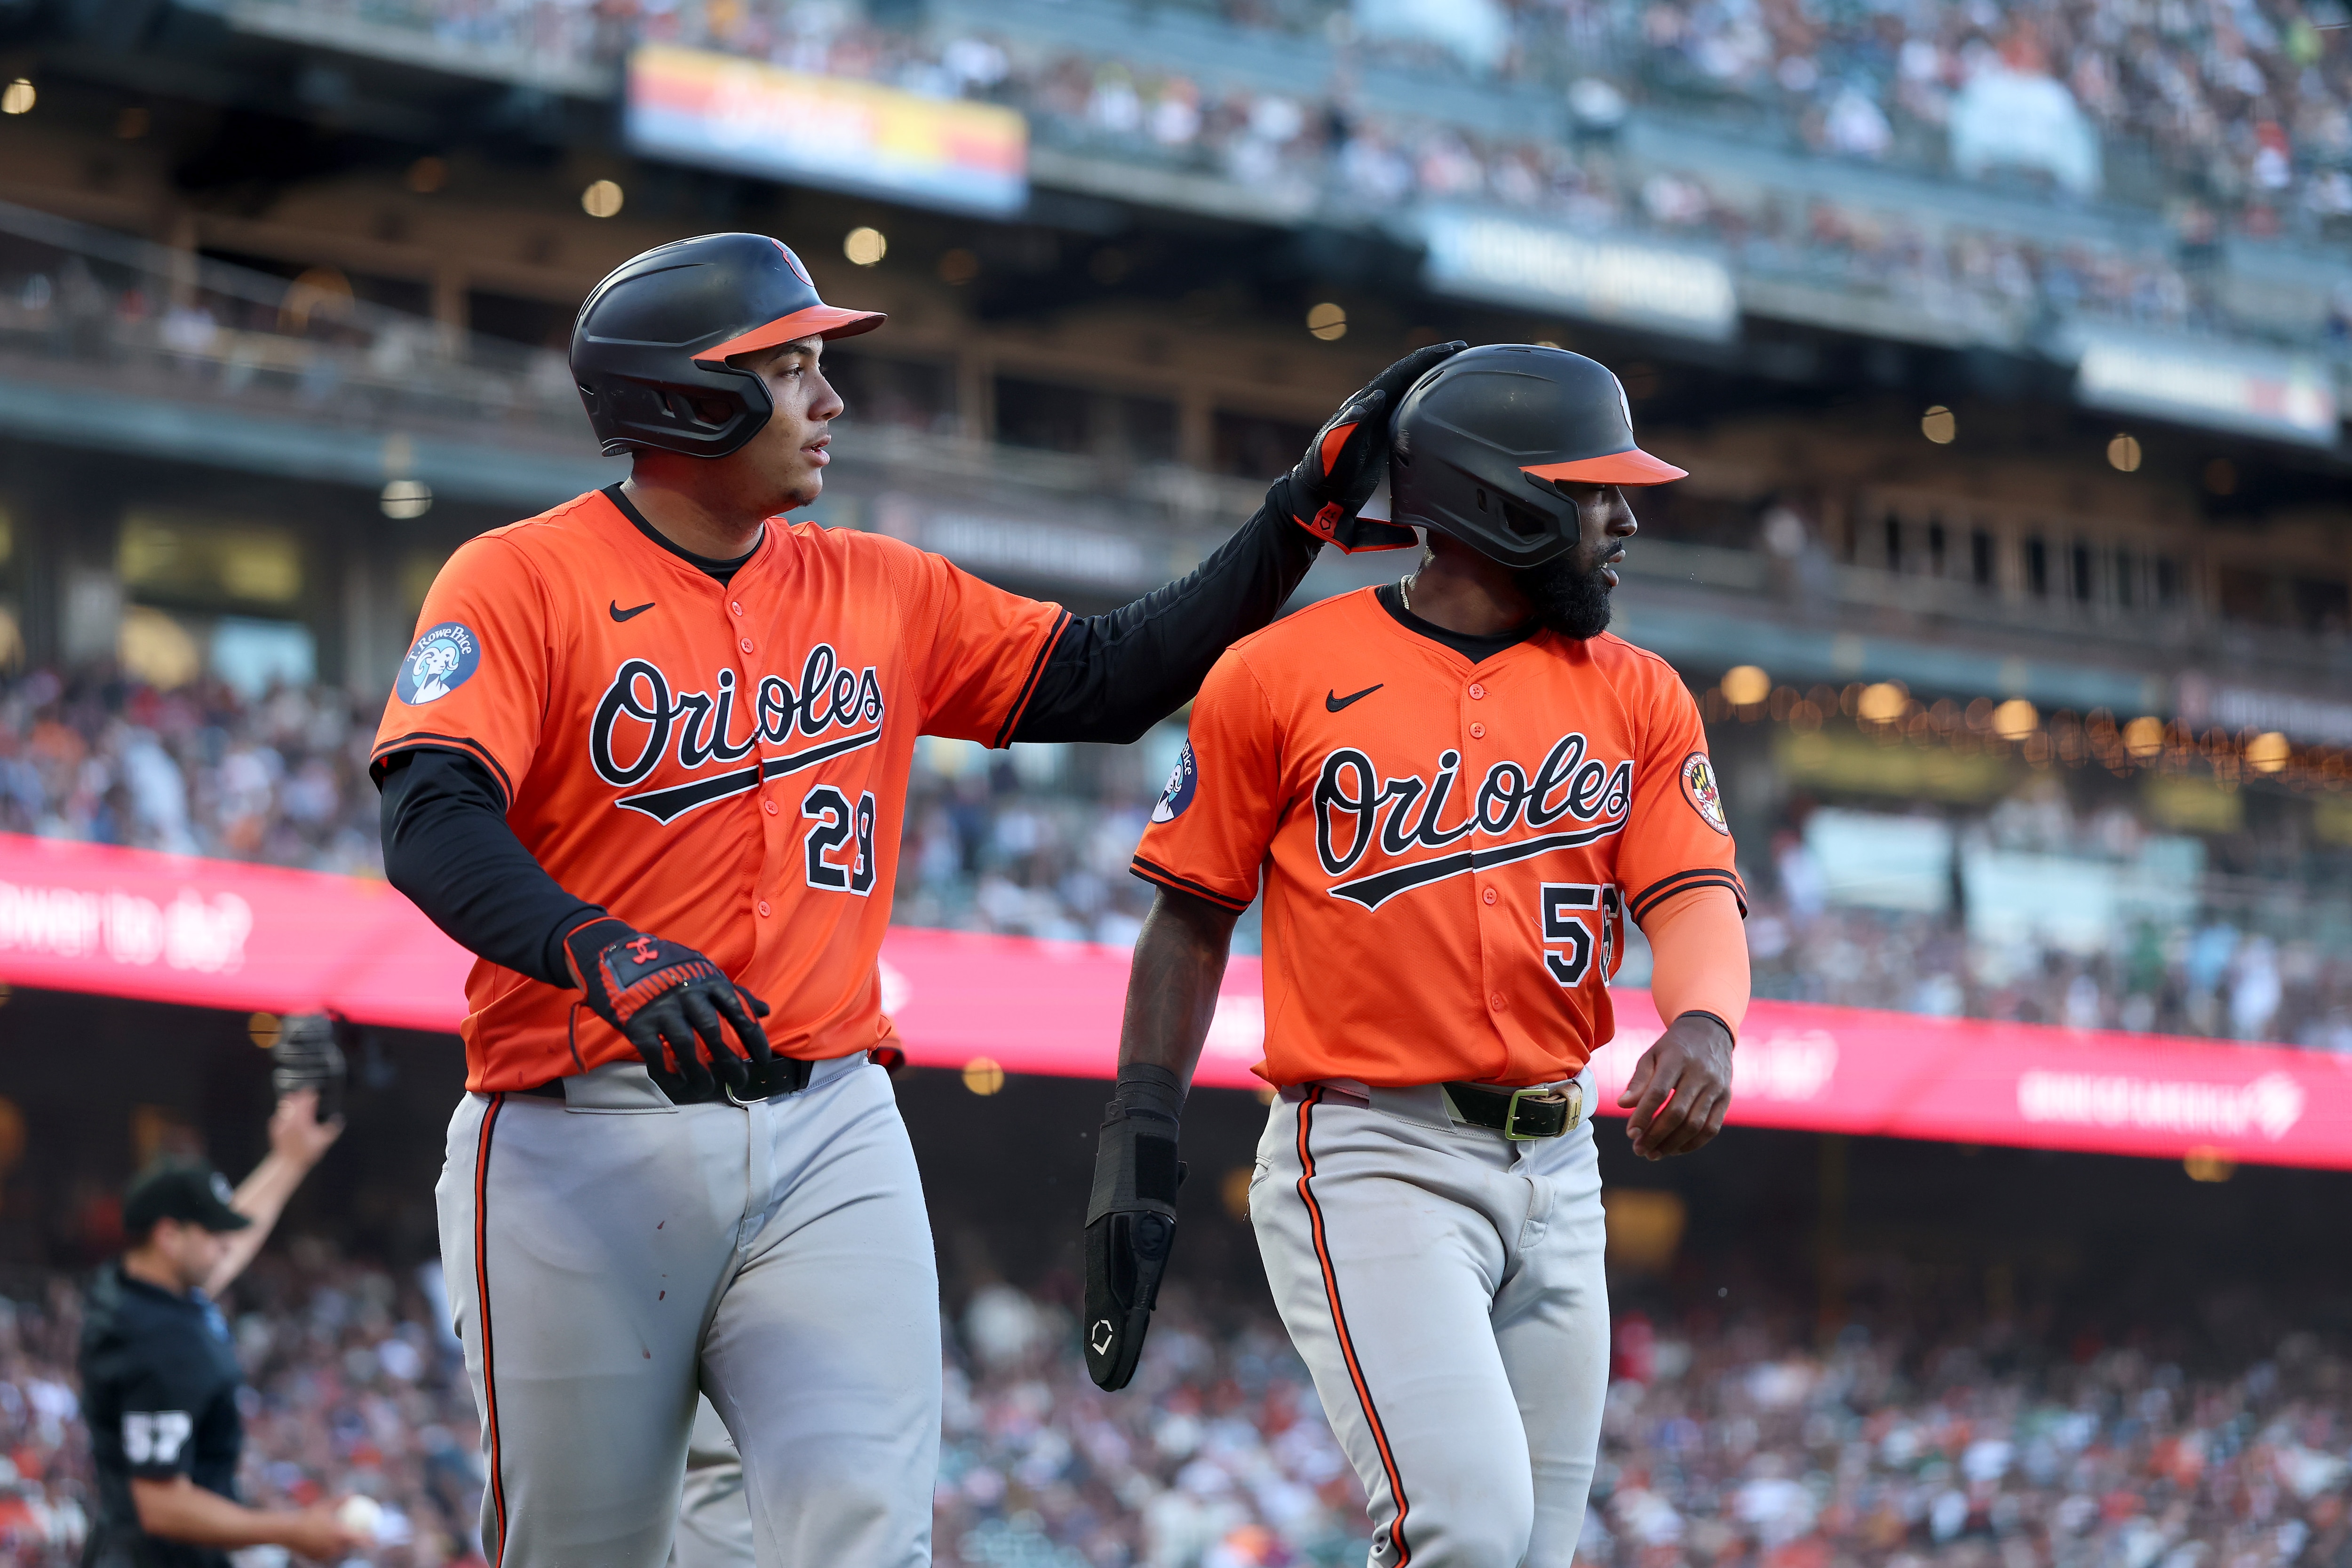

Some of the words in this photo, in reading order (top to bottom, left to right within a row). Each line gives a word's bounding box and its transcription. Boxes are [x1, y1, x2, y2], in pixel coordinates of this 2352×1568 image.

[406, 651, 421, 662] T.
[417, 628, 452, 651] Rowe
[449, 626, 472, 655] Price
[589, 643, 885, 788] Orioles
[1182, 742, 1192, 776] Price
[801, 784, 877, 898] 29
[1313, 732, 1635, 876] Orioles
[1540, 882, 1621, 988] 56
